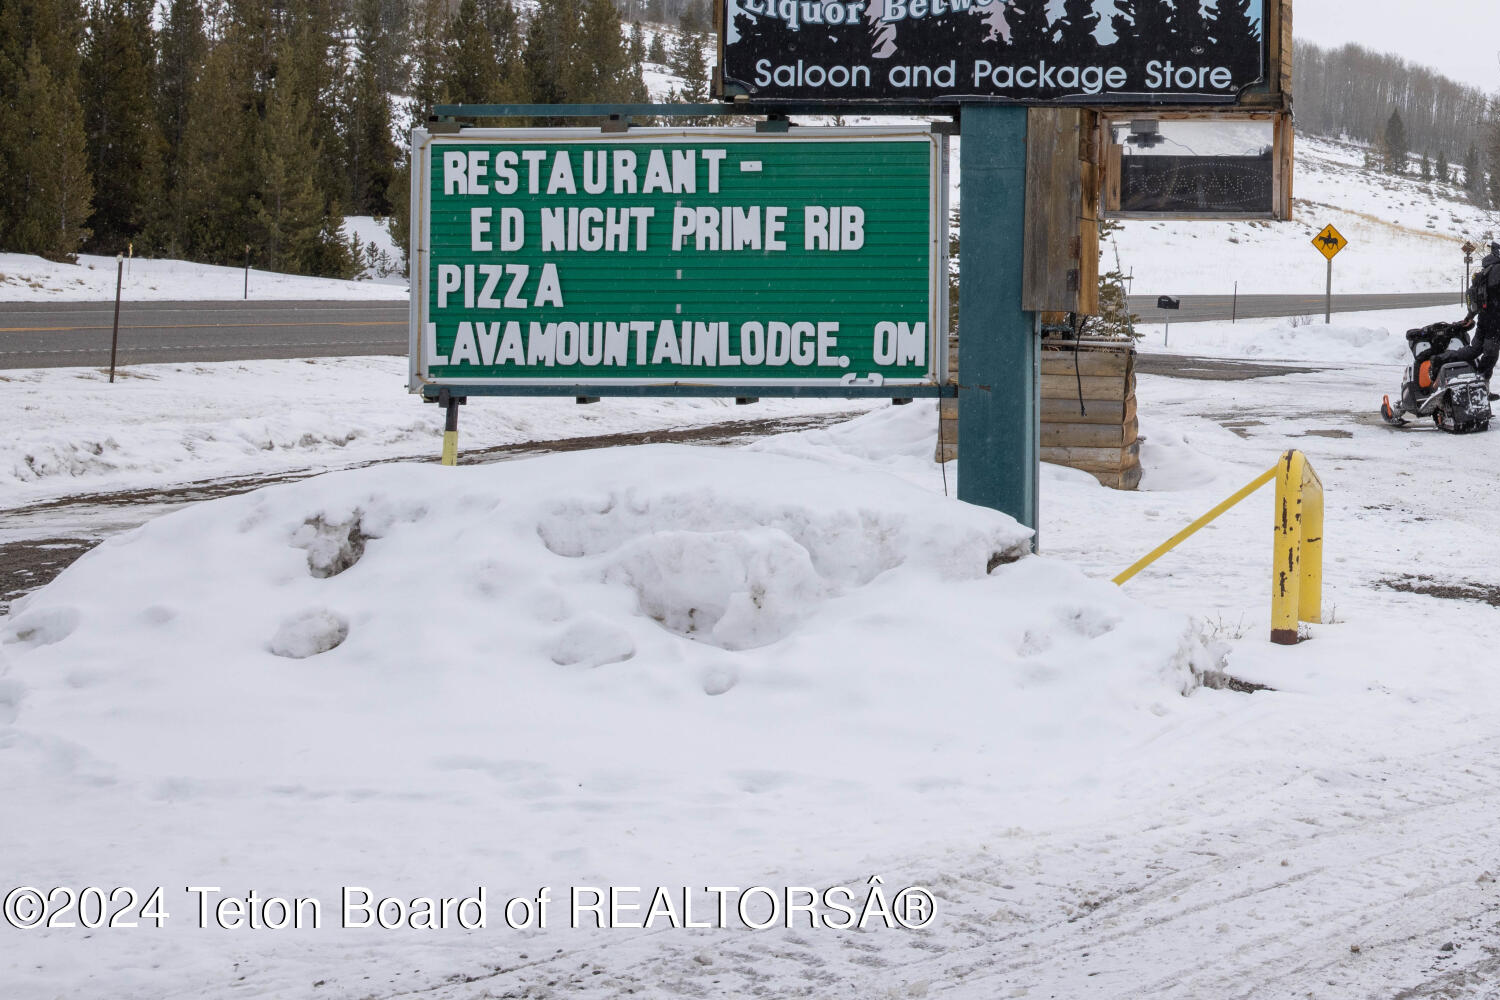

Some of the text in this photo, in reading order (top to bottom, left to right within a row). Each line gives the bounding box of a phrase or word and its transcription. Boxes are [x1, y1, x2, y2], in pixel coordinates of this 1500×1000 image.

[755, 58, 1232, 95] Saloon and Package Store
[471, 205, 865, 252] ED NIGHT PRIME RIB
[438, 263, 564, 309] PIZZA
